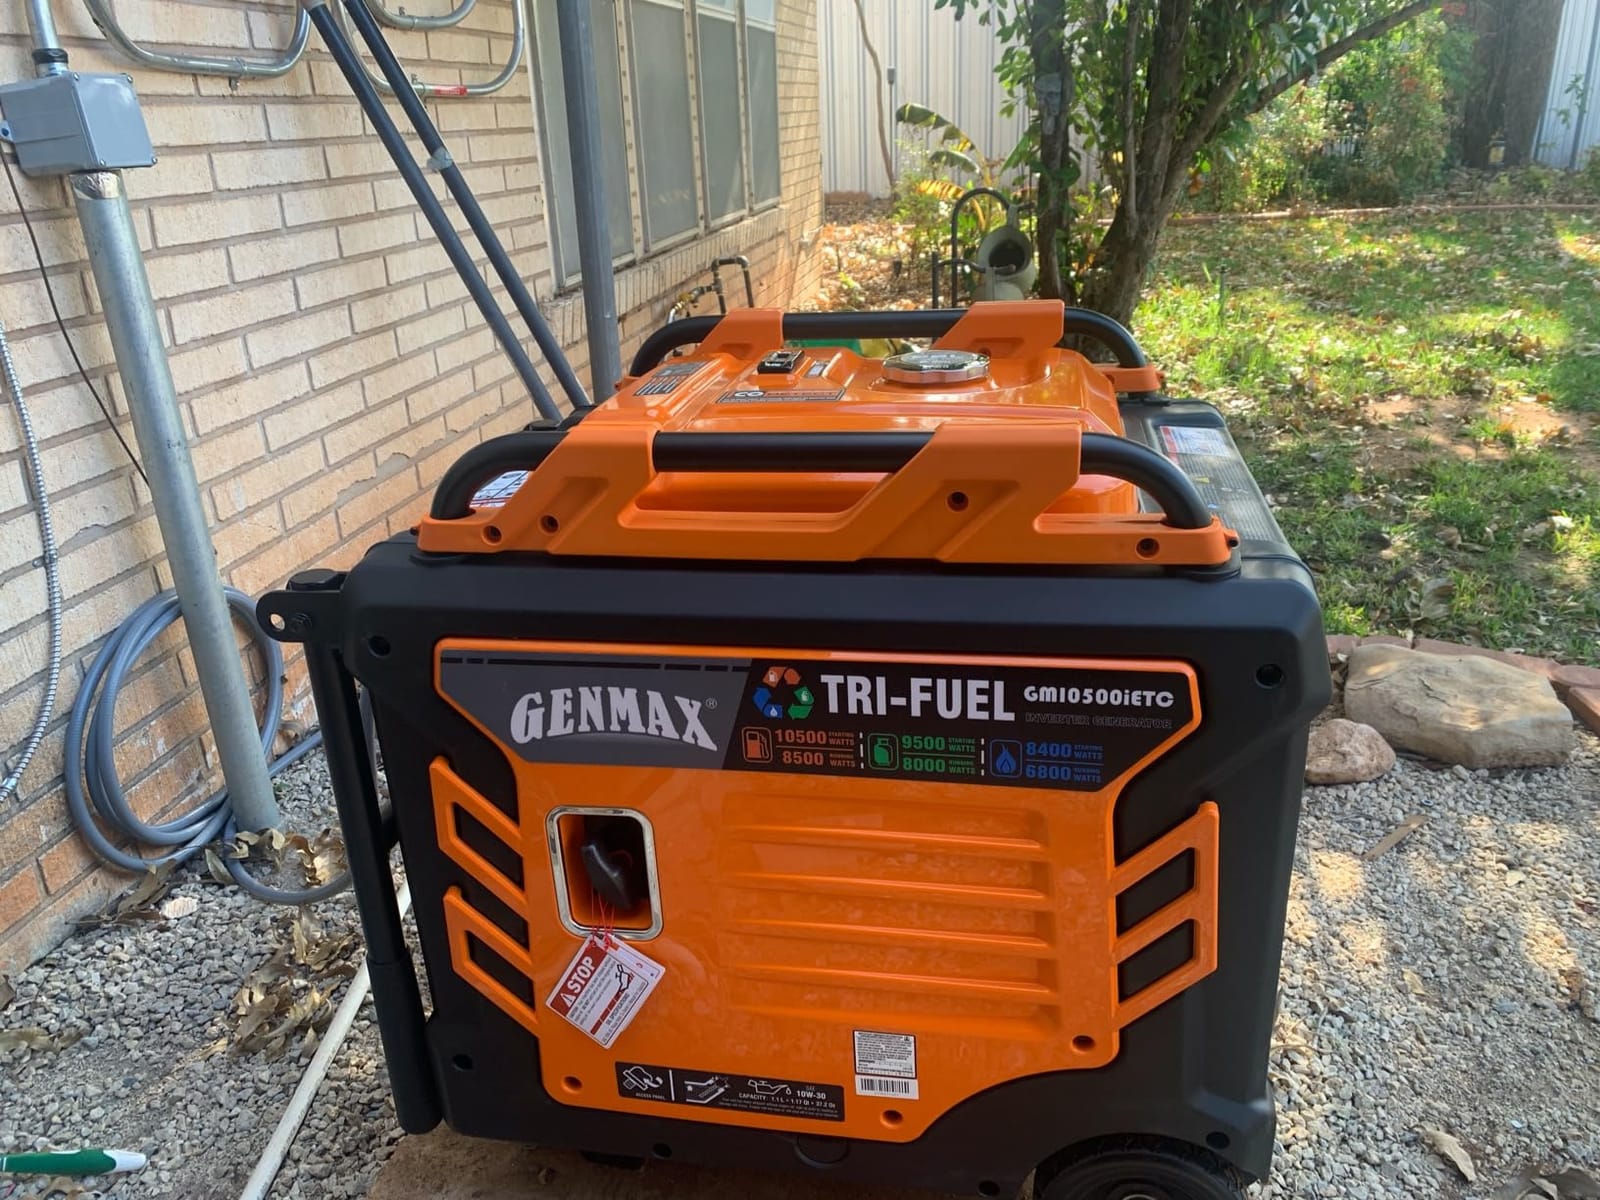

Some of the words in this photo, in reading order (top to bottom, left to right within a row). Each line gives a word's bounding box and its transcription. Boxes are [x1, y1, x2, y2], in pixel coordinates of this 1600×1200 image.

[820, 674, 1016, 722] TRI-FUEL
[510, 686, 717, 751] GENMAX
[1025, 711, 1090, 726] INVERTER
[1092, 715, 1173, 730] GENERATOR
[774, 728, 827, 745] 10500
[828, 738, 855, 746] WATTS
[901, 735, 946, 751] 9500
[948, 744, 976, 753] WATTS
[1026, 741, 1073, 758] 8400
[1073, 751, 1104, 760] WATTS
[782, 750, 824, 766] 8500
[829, 759, 856, 768] WATTS
[902, 757, 946, 773] 8000
[948, 766, 976, 775] WATTS
[1025, 765, 1072, 781] 6800
[567, 956, 595, 994] STOP
[796, 1090, 827, 1100] 10W-30
